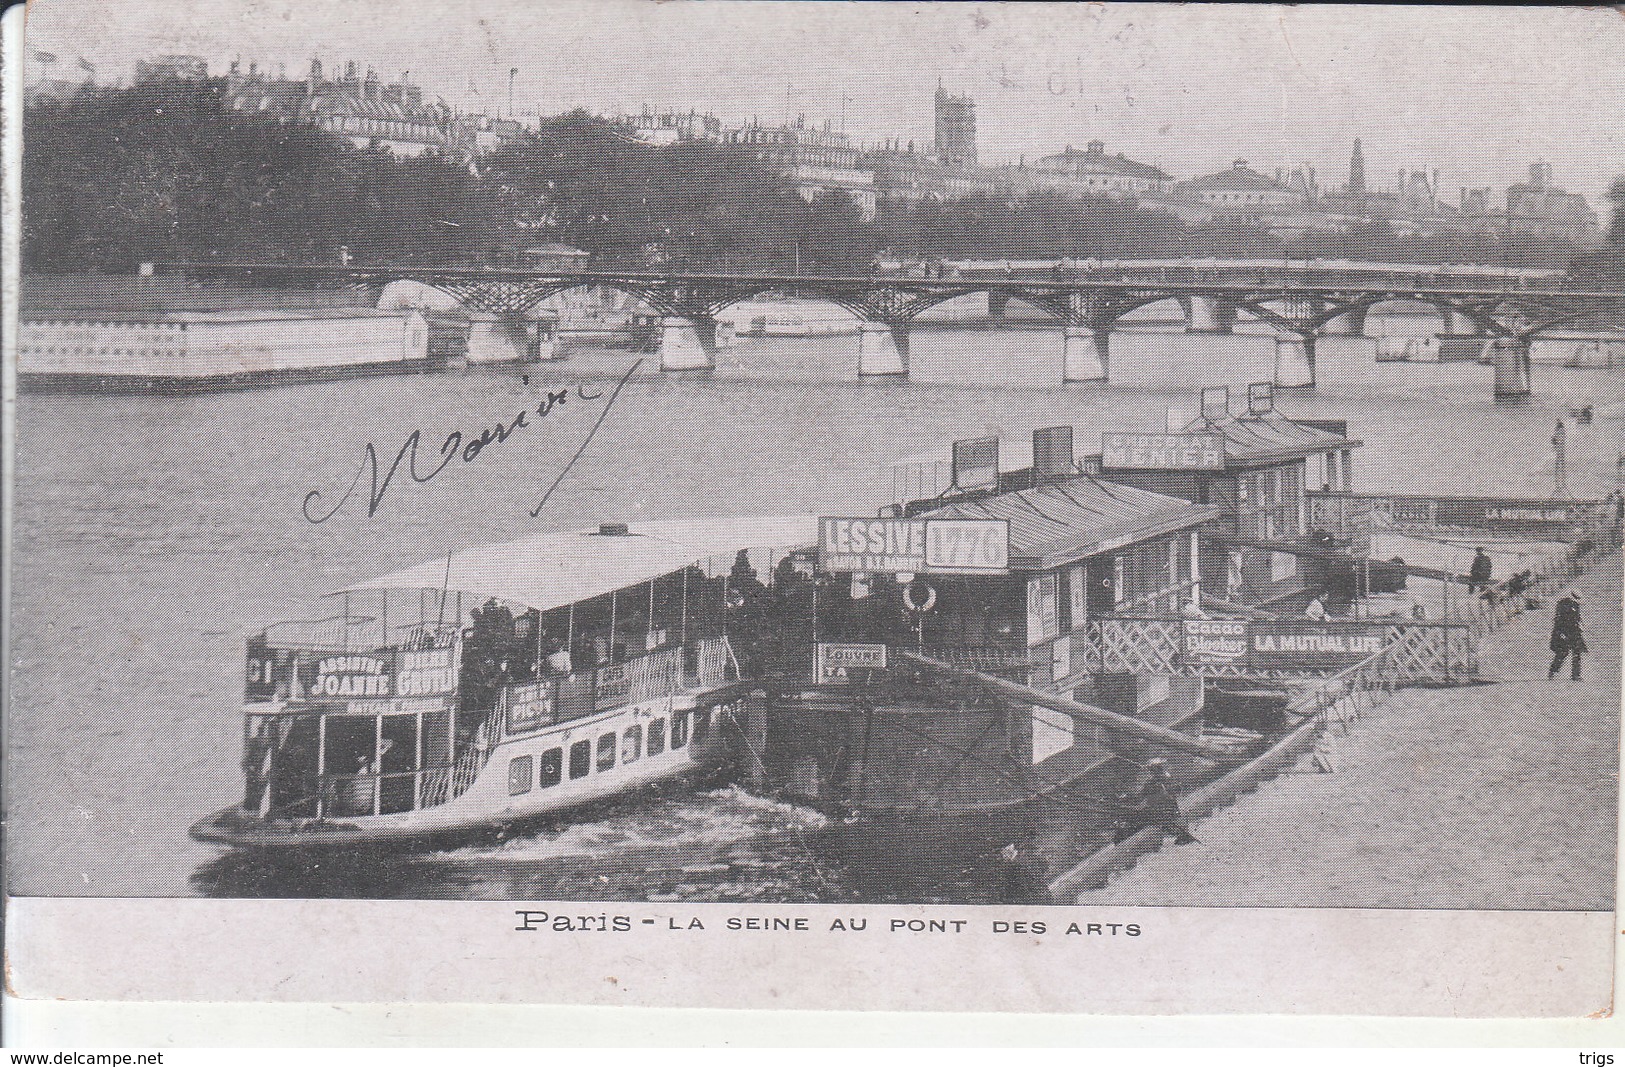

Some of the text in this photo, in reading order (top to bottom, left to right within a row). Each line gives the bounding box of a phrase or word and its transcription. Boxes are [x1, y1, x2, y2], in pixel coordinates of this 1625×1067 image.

[1111, 435, 1213, 448] CHOCOLAT
[1104, 447, 1219, 466] MENIER
[825, 519, 1001, 564] LESSIVE 1776
[1187, 621, 1244, 635] Cacao
[1187, 635, 1247, 653] Blooker
[1254, 635, 1381, 653] LA MUTUAL LIFE
[826, 646, 880, 661] LOUVRE
[319, 656, 386, 675] ABSINTHE
[311, 675, 390, 696] JOANNE
